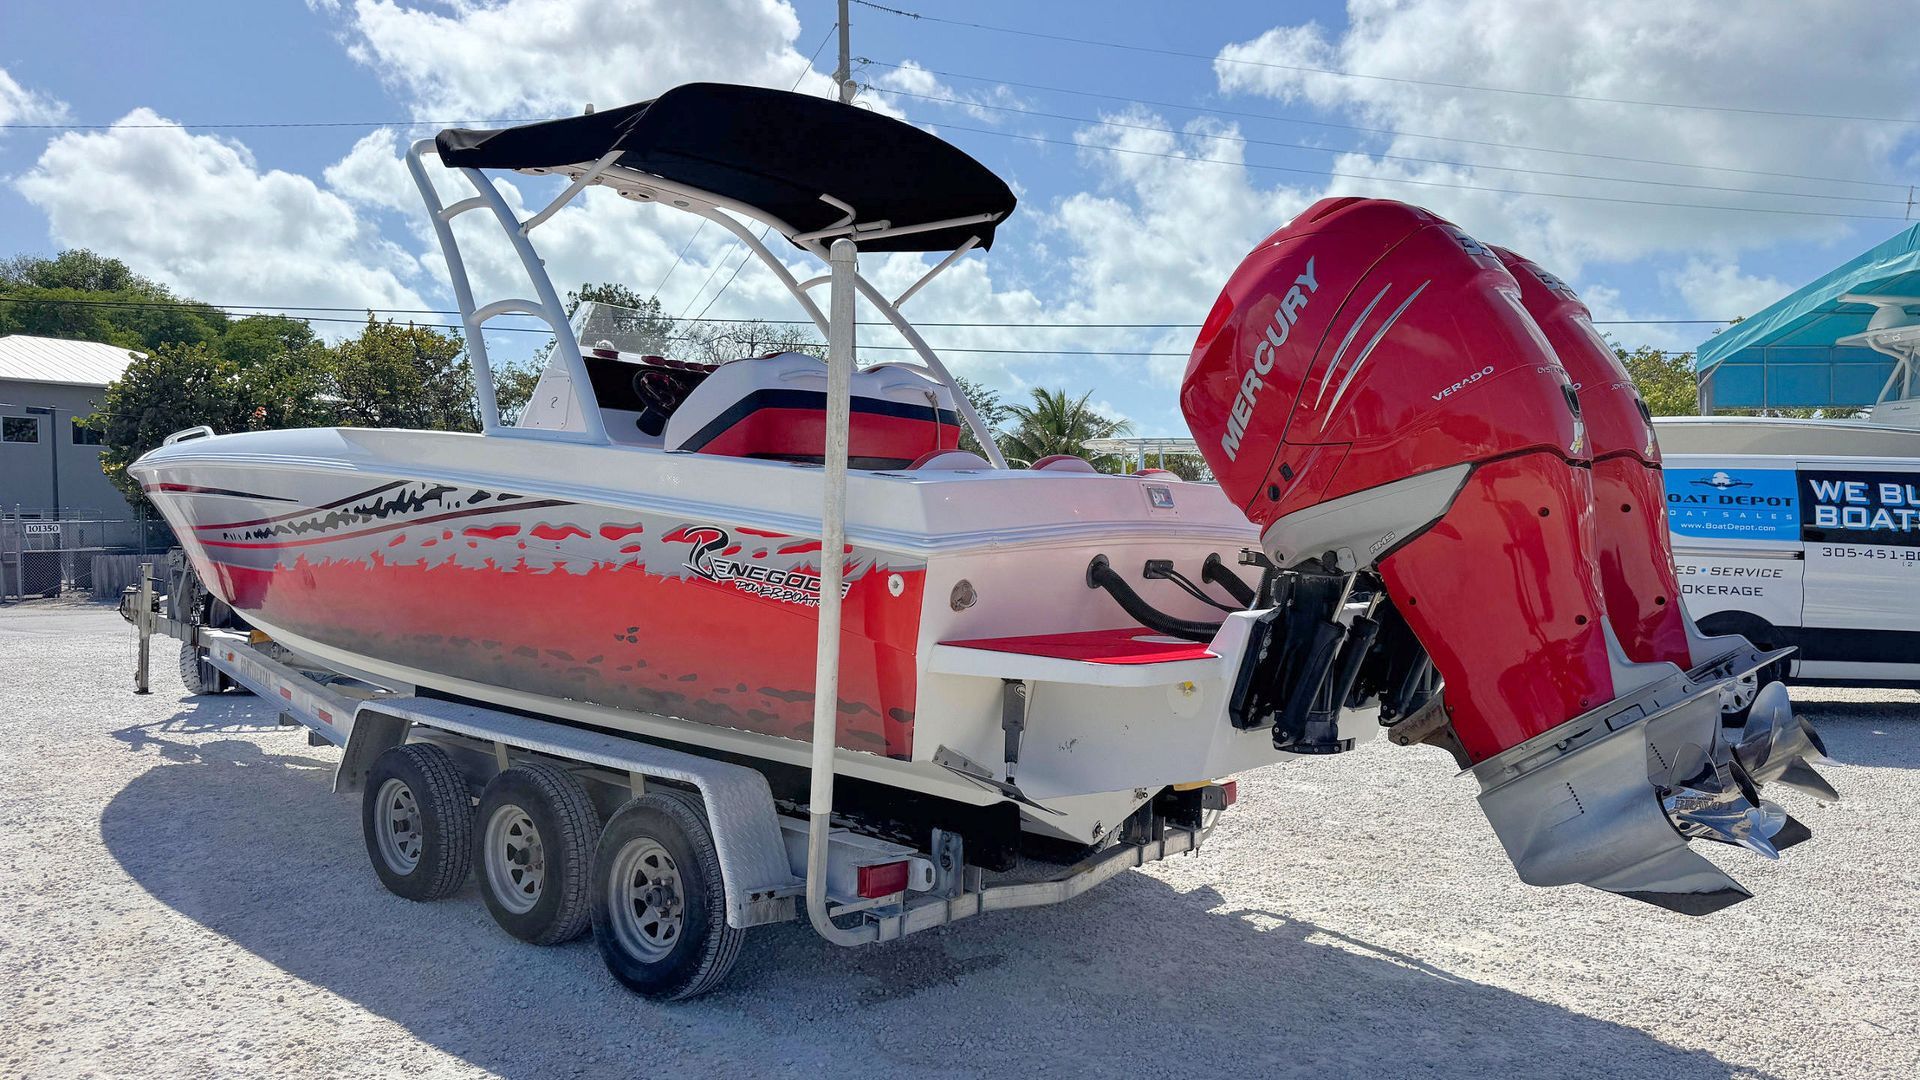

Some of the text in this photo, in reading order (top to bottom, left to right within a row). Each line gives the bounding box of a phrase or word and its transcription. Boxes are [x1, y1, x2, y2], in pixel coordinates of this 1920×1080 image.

[1221, 256, 1319, 462] MERCURY
[1431, 365, 1494, 401] VERADO
[1809, 480, 1868, 503] WE
[1719, 495, 1794, 507] DEPOT
[1723, 511, 1793, 520] SALES
[1815, 505, 1920, 531] BOAT
[28, 525, 59, 533] 101350
[1680, 522, 1776, 531] www.BoatDepot.com
[1369, 530, 1396, 555] AMS
[1823, 547, 1920, 561] 305-451-B
[1710, 567, 1783, 578] SERVICE
